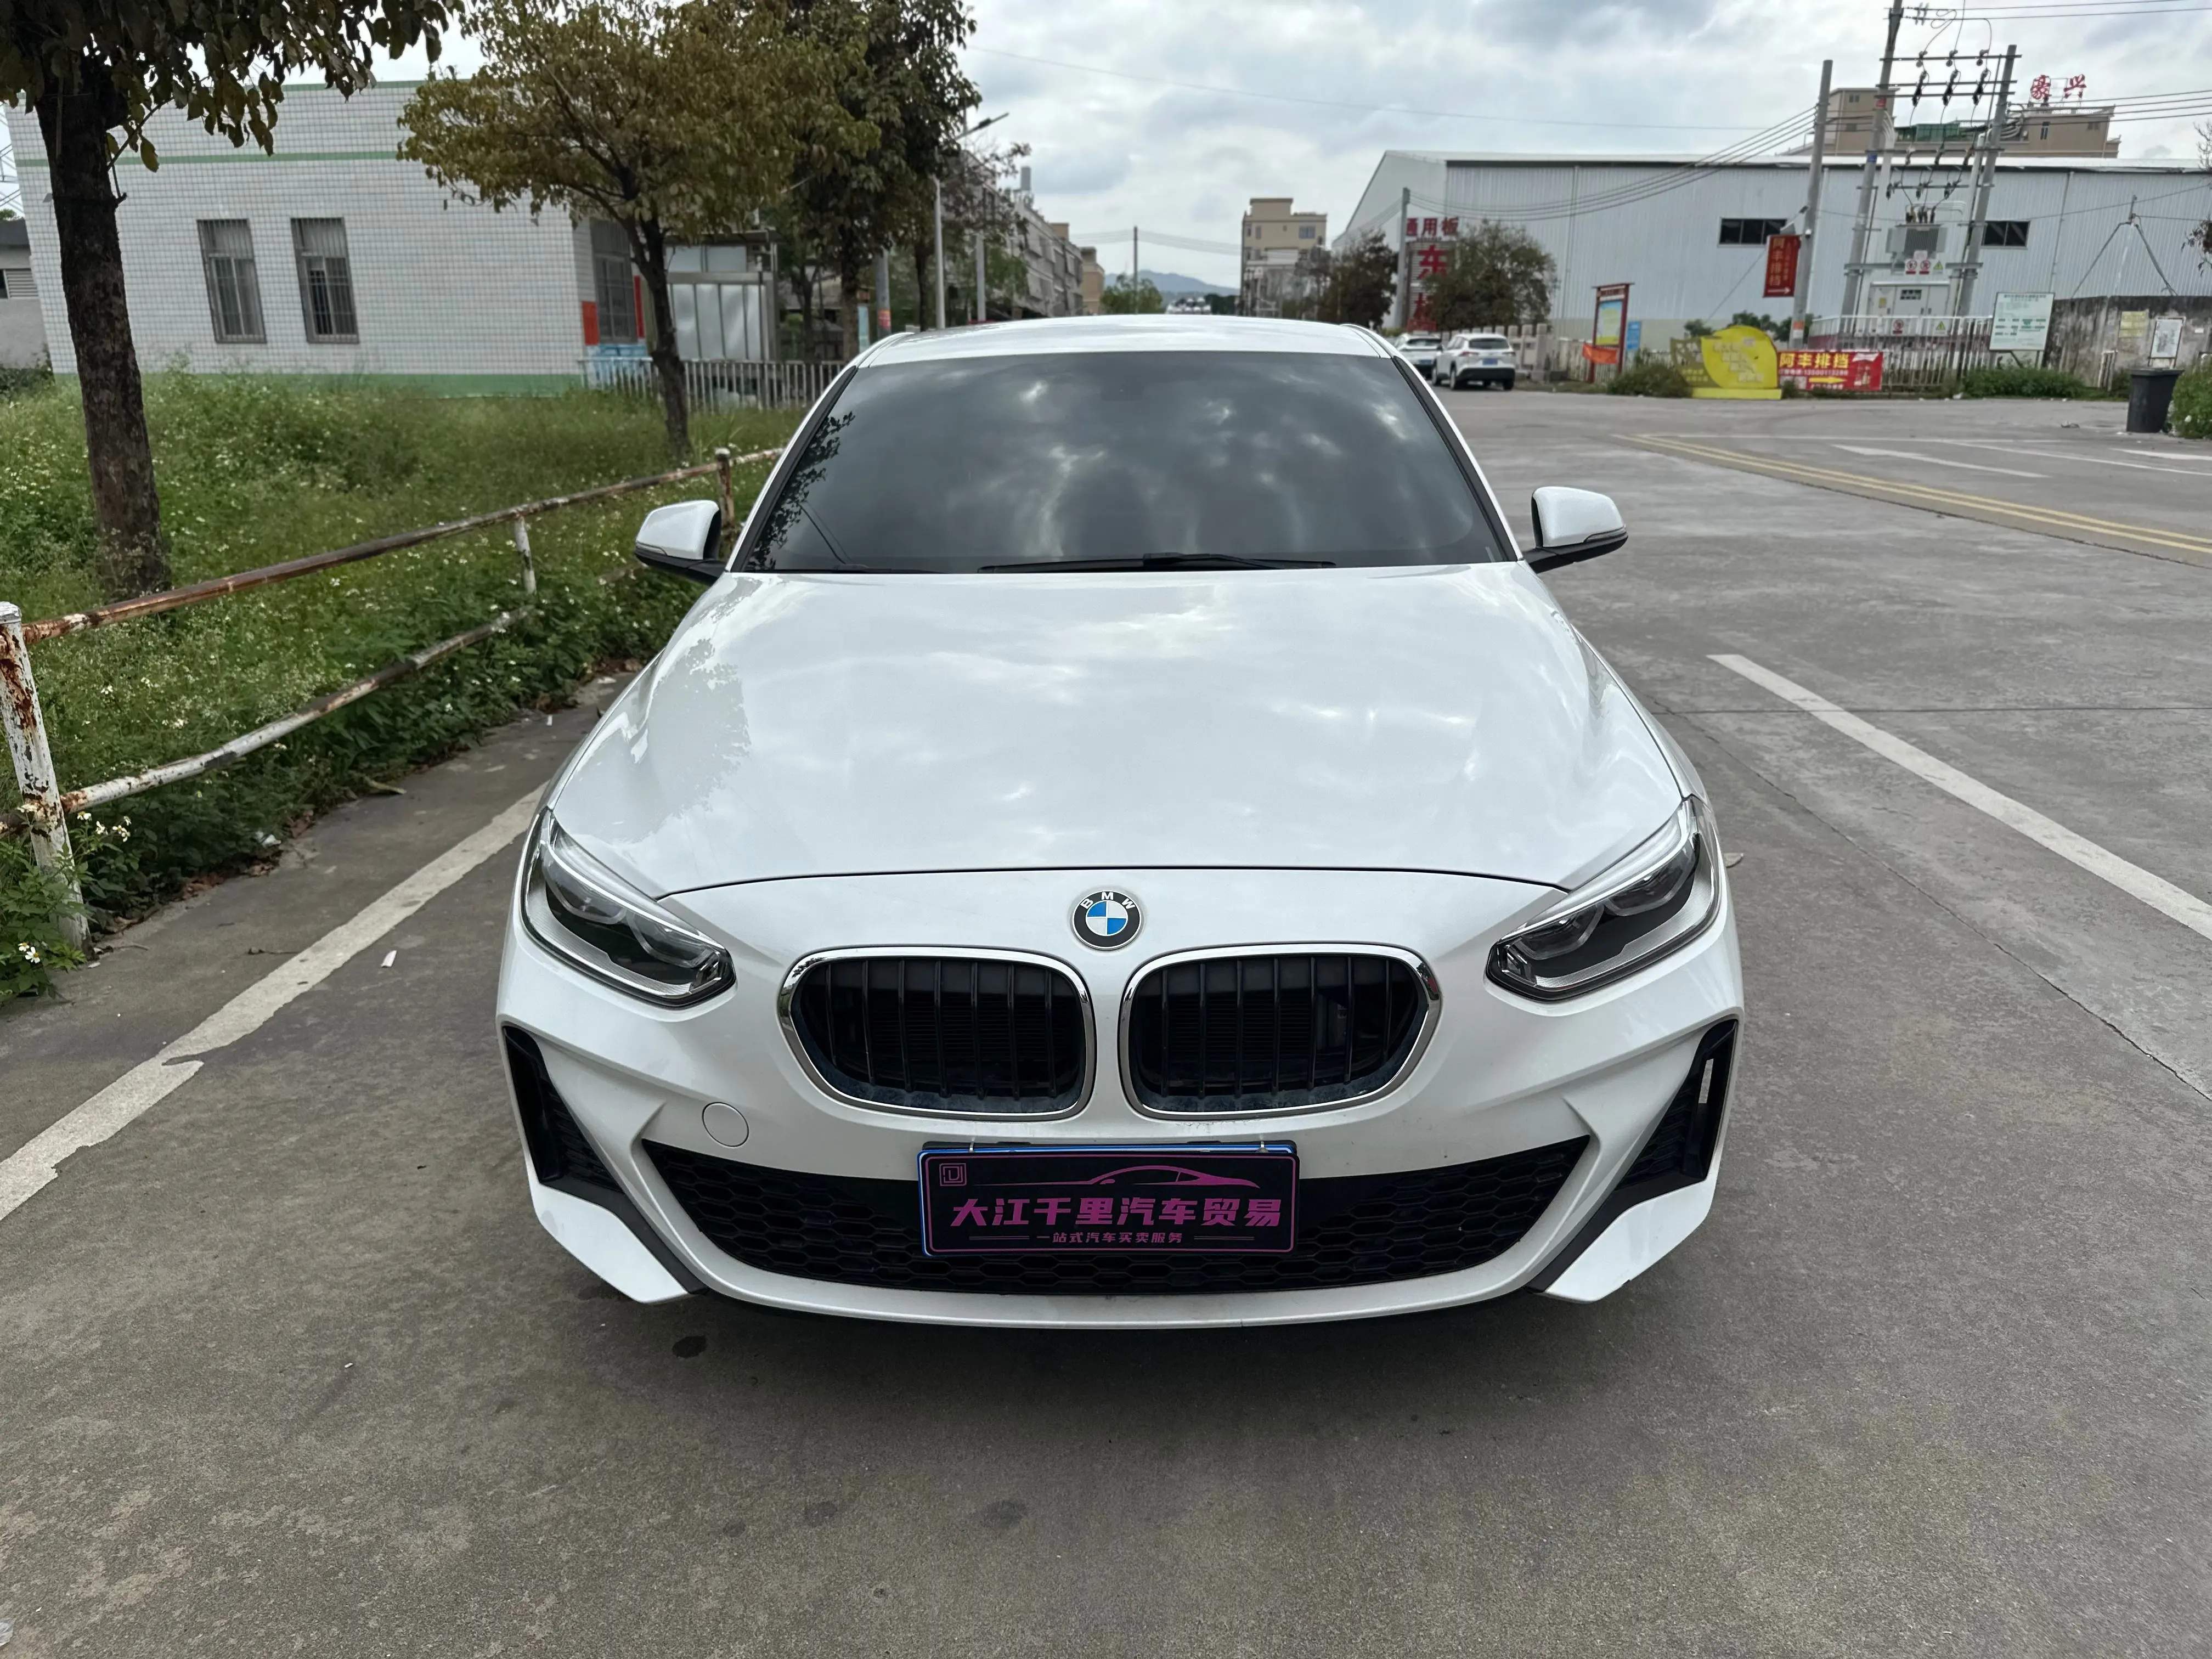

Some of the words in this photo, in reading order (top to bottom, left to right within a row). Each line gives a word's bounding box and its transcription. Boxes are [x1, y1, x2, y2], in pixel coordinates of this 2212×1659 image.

[1779, 353, 1849, 369] 阿丰排档
[1080, 891, 1136, 910] BMW
[950, 1197, 1282, 1227] 大江千里汽车贸易
[1037, 1232, 1183, 1243] 一站式汽车买卖服务
